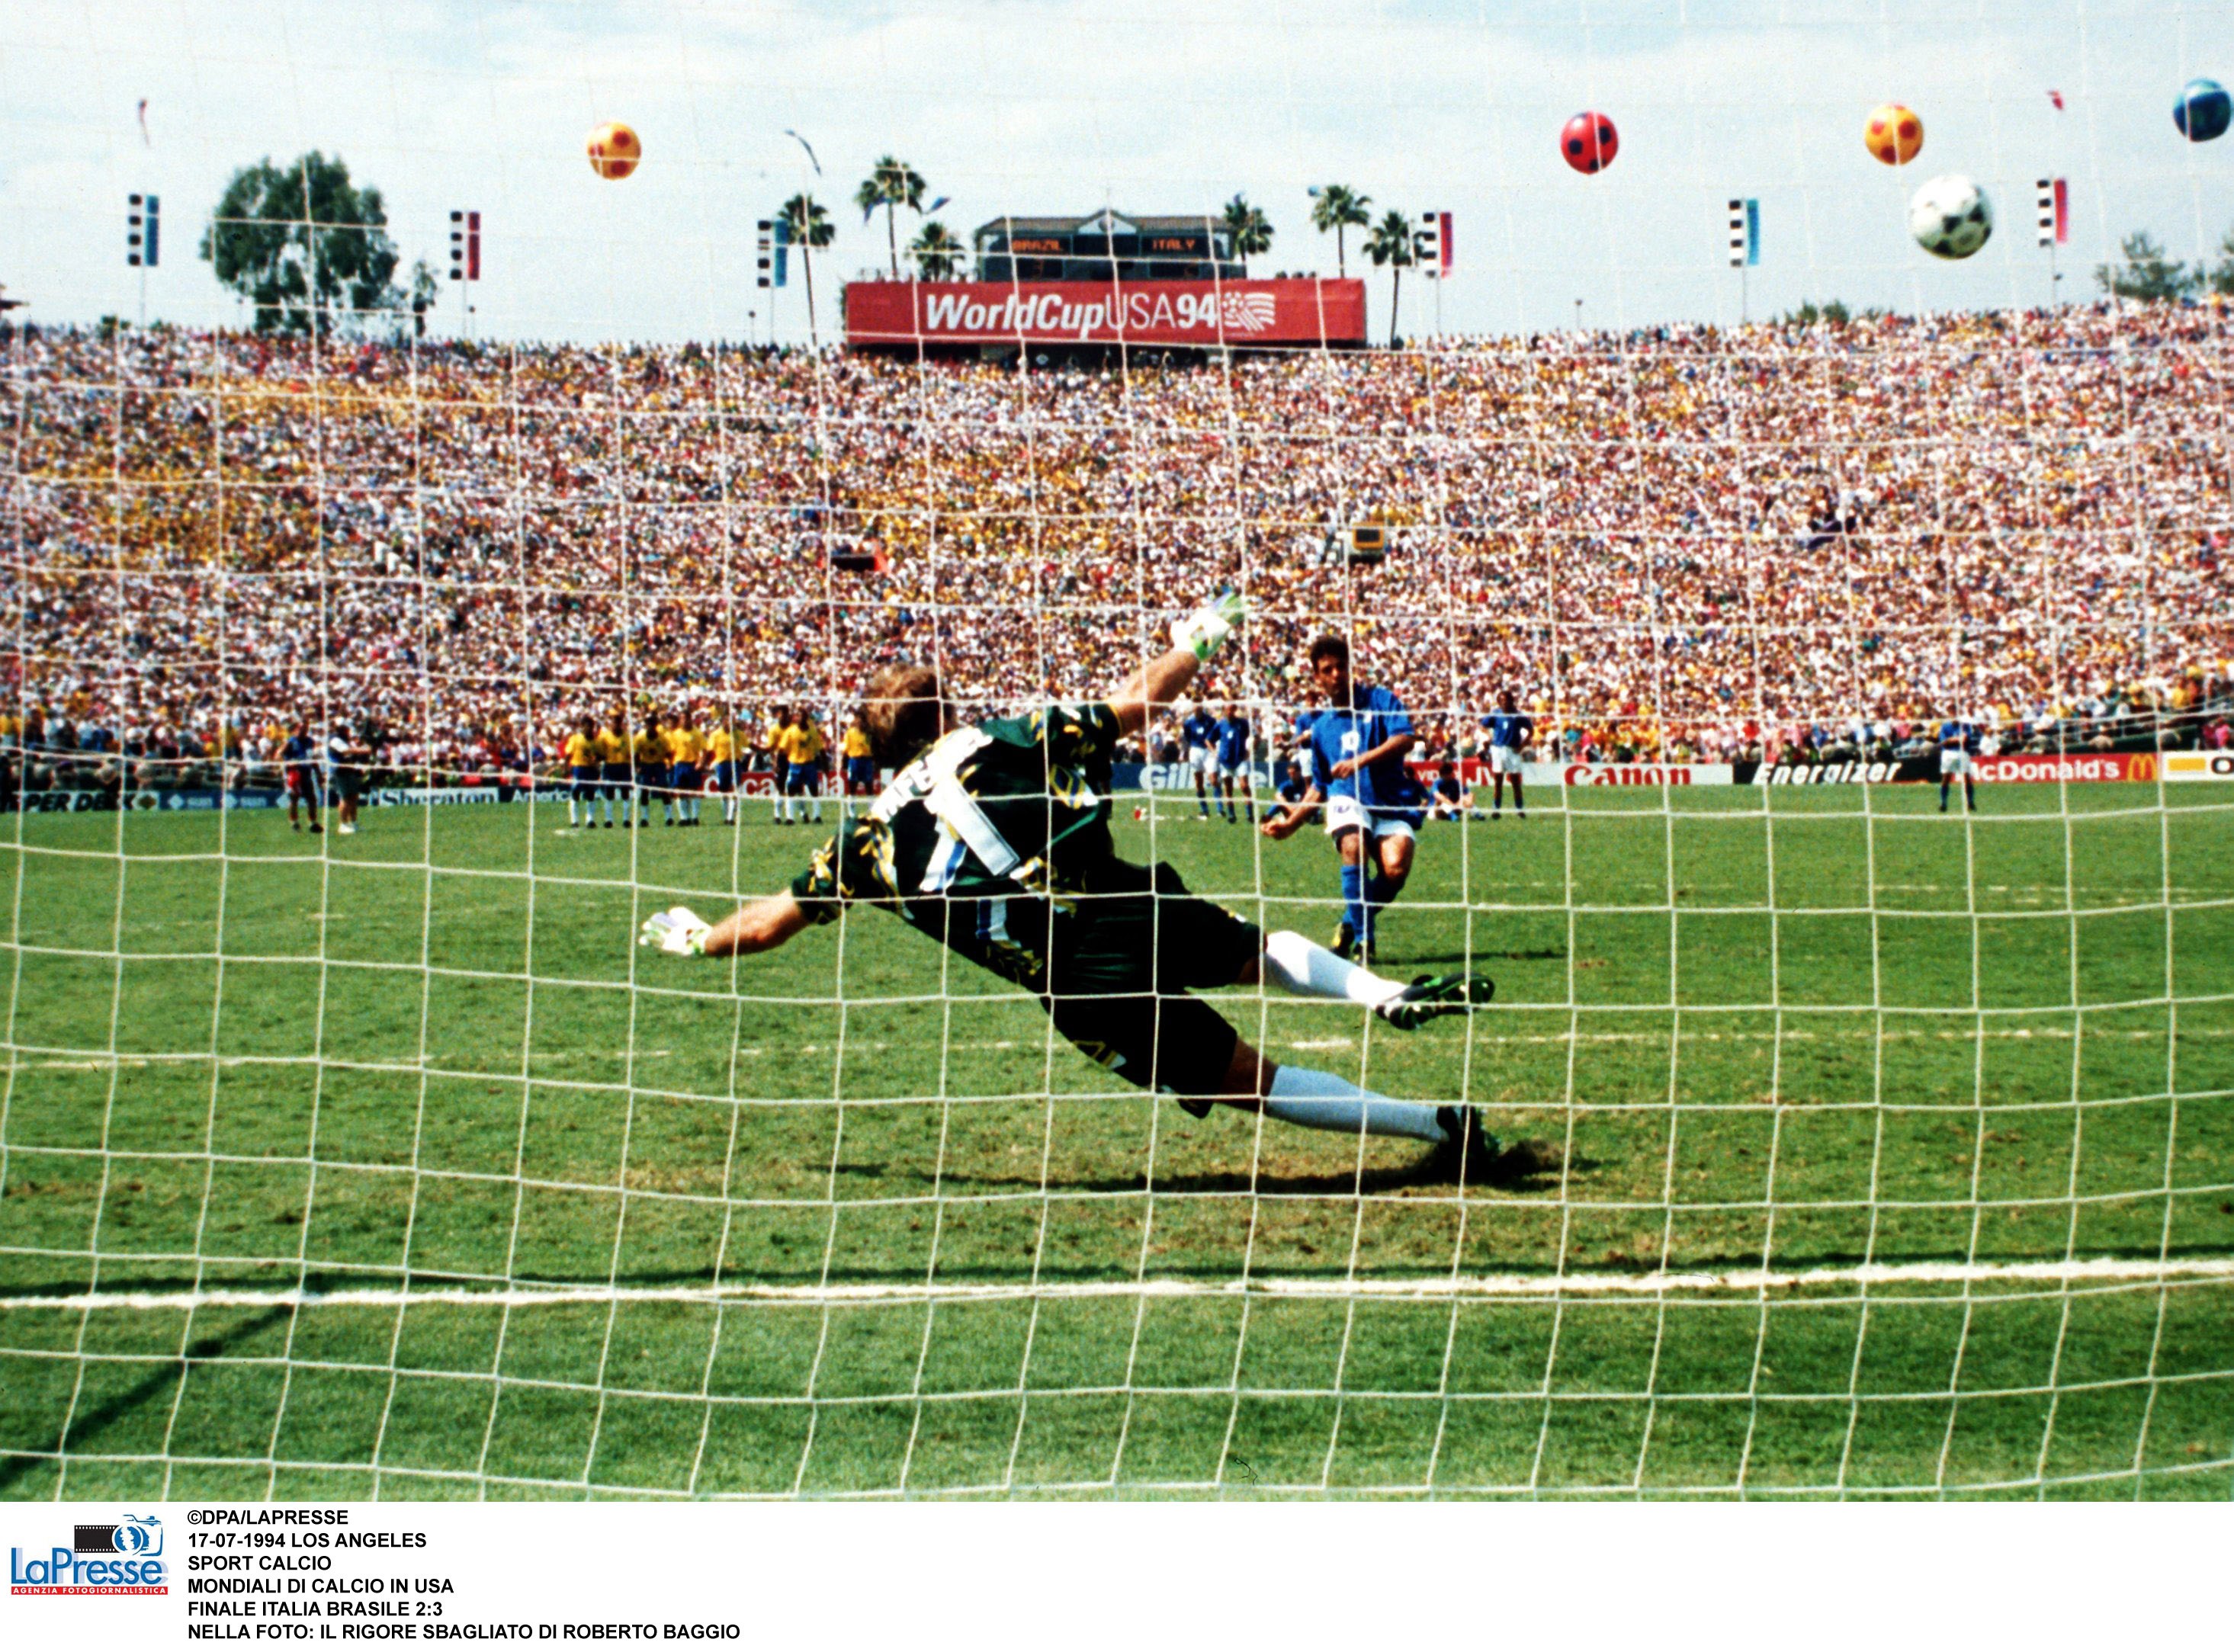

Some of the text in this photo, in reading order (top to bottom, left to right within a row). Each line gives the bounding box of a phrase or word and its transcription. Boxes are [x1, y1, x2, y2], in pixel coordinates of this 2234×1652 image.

[1152, 239, 1196, 250] ITALY
[1565, 765, 1690, 785] Canon
[1752, 760, 1902, 784] Energizer
[382, 790, 495, 805] Sheraton
